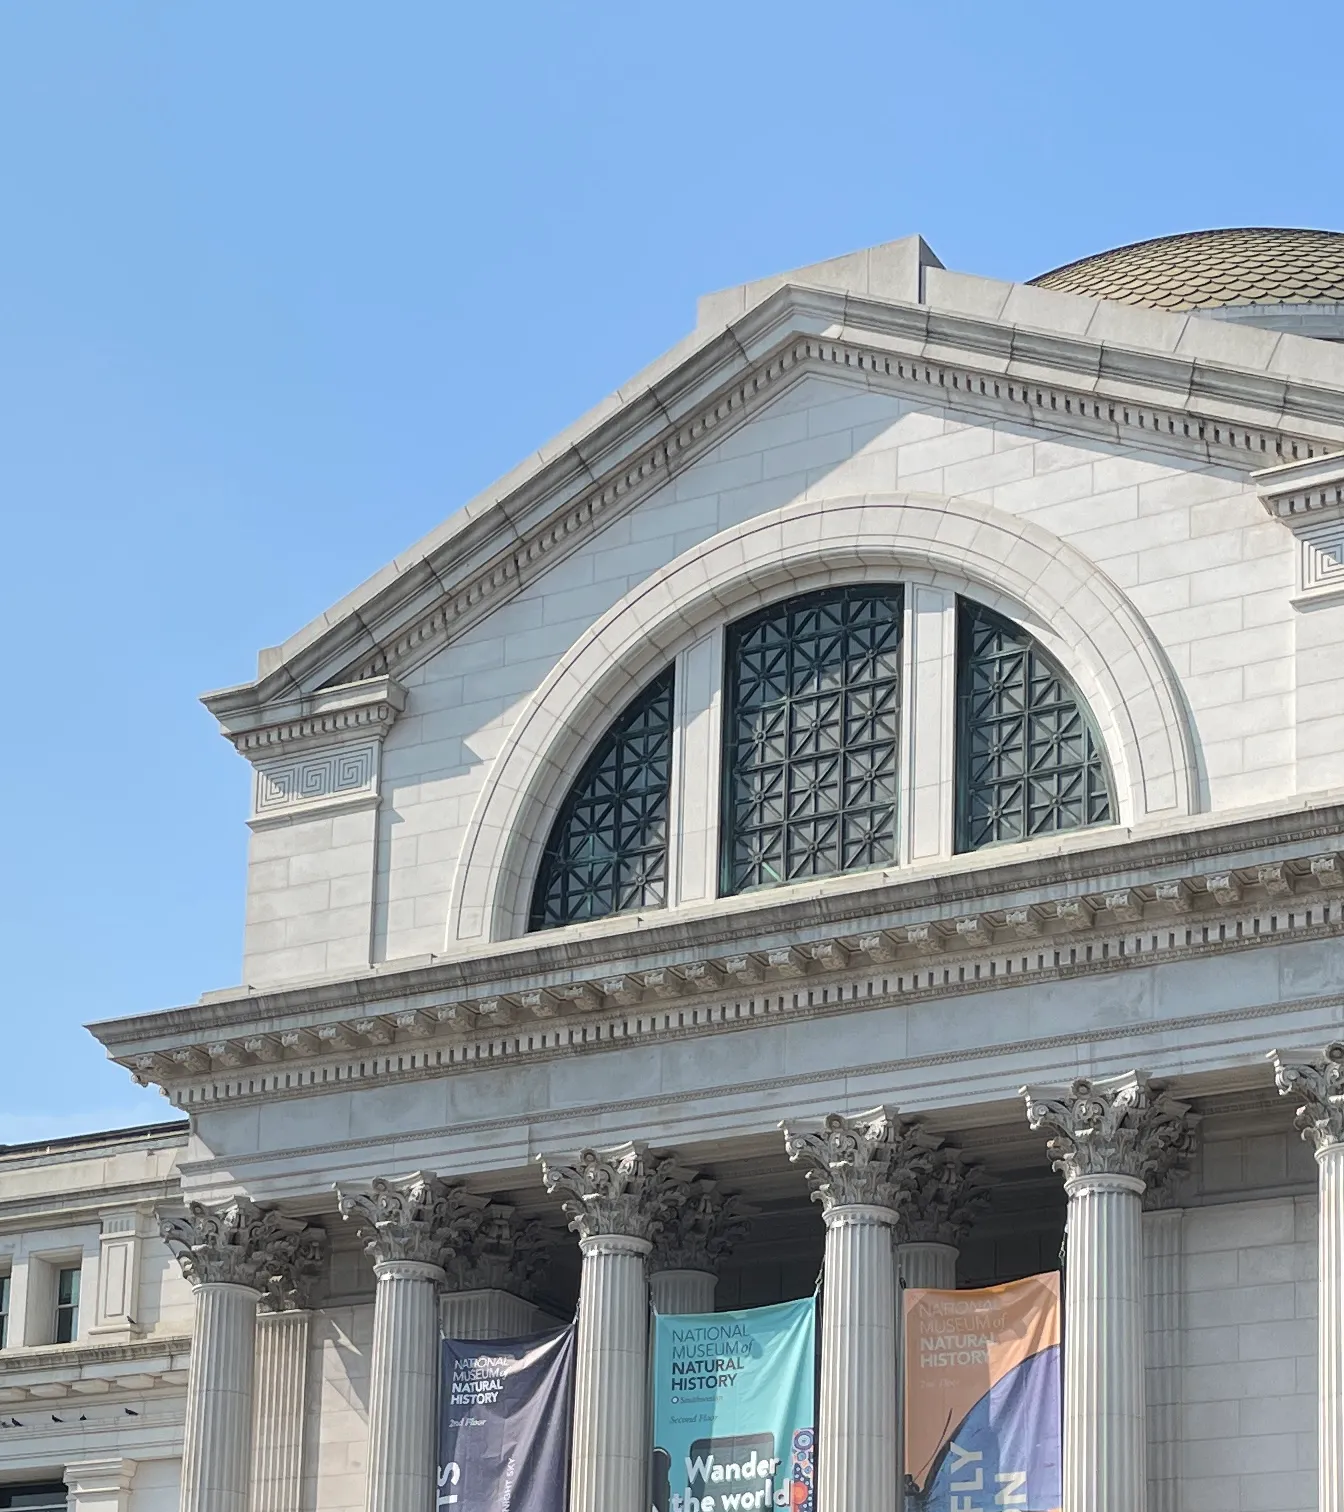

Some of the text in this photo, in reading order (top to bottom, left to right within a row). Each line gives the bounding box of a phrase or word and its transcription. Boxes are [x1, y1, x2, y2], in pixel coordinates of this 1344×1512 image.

[672, 1323, 750, 1342] NATIONAL
[920, 1312, 1008, 1334] MUSEUM of
[672, 1339, 754, 1359] MUSEUM of
[920, 1331, 998, 1351] NATURAL
[454, 1356, 509, 1370] NATIONAL
[671, 1357, 744, 1375] NATURAL
[920, 1349, 990, 1368] HISTORY
[452, 1367, 499, 1382] MUSEUM
[671, 1373, 738, 1391] HISTORY
[451, 1378, 504, 1393] NATURAL
[450, 1391, 498, 1405] HISTORY
[506, 1457, 516, 1478] SKY
[685, 1450, 781, 1484] Wander
[721, 1478, 792, 1512] world
